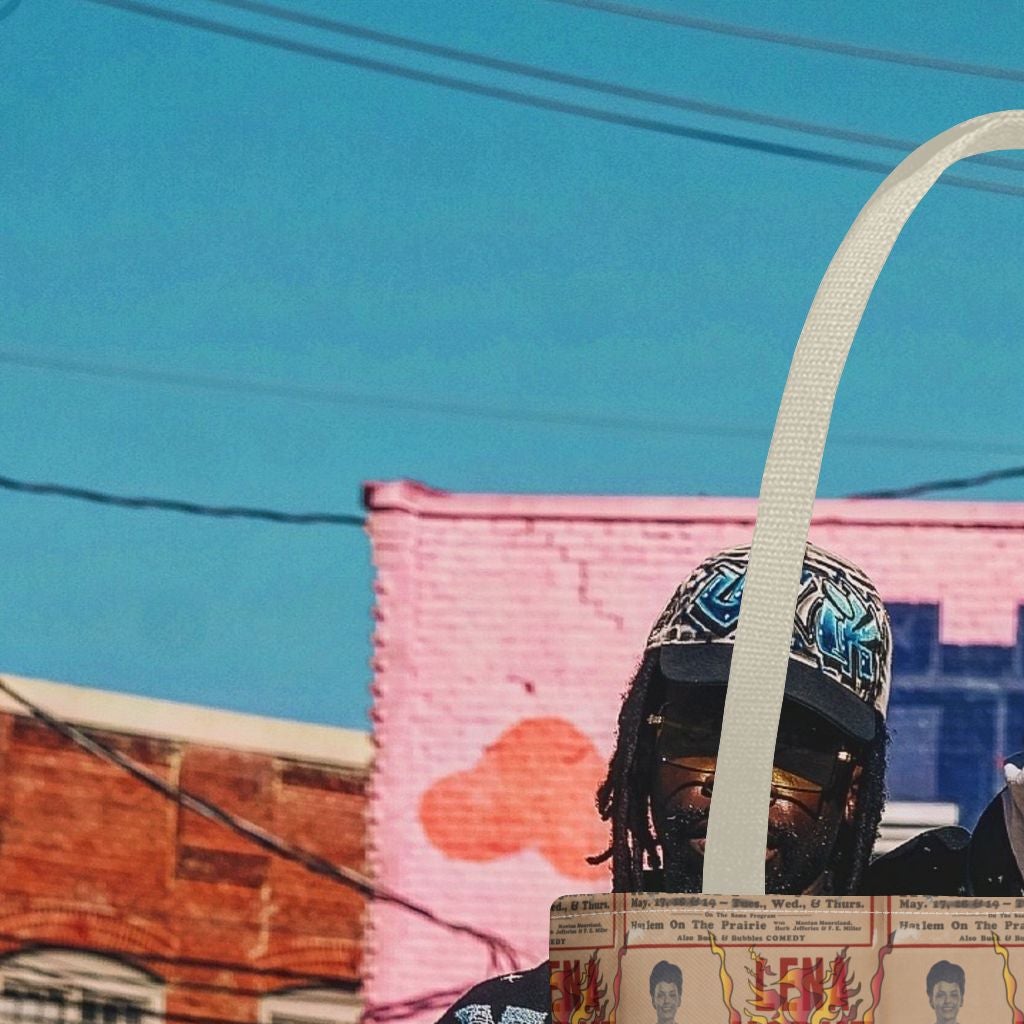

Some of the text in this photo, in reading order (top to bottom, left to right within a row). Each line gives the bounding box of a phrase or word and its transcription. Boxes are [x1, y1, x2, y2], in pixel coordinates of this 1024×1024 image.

[899, 899, 927, 910] May.
[951, 921, 969, 931] On
[976, 921, 998, 931] The
